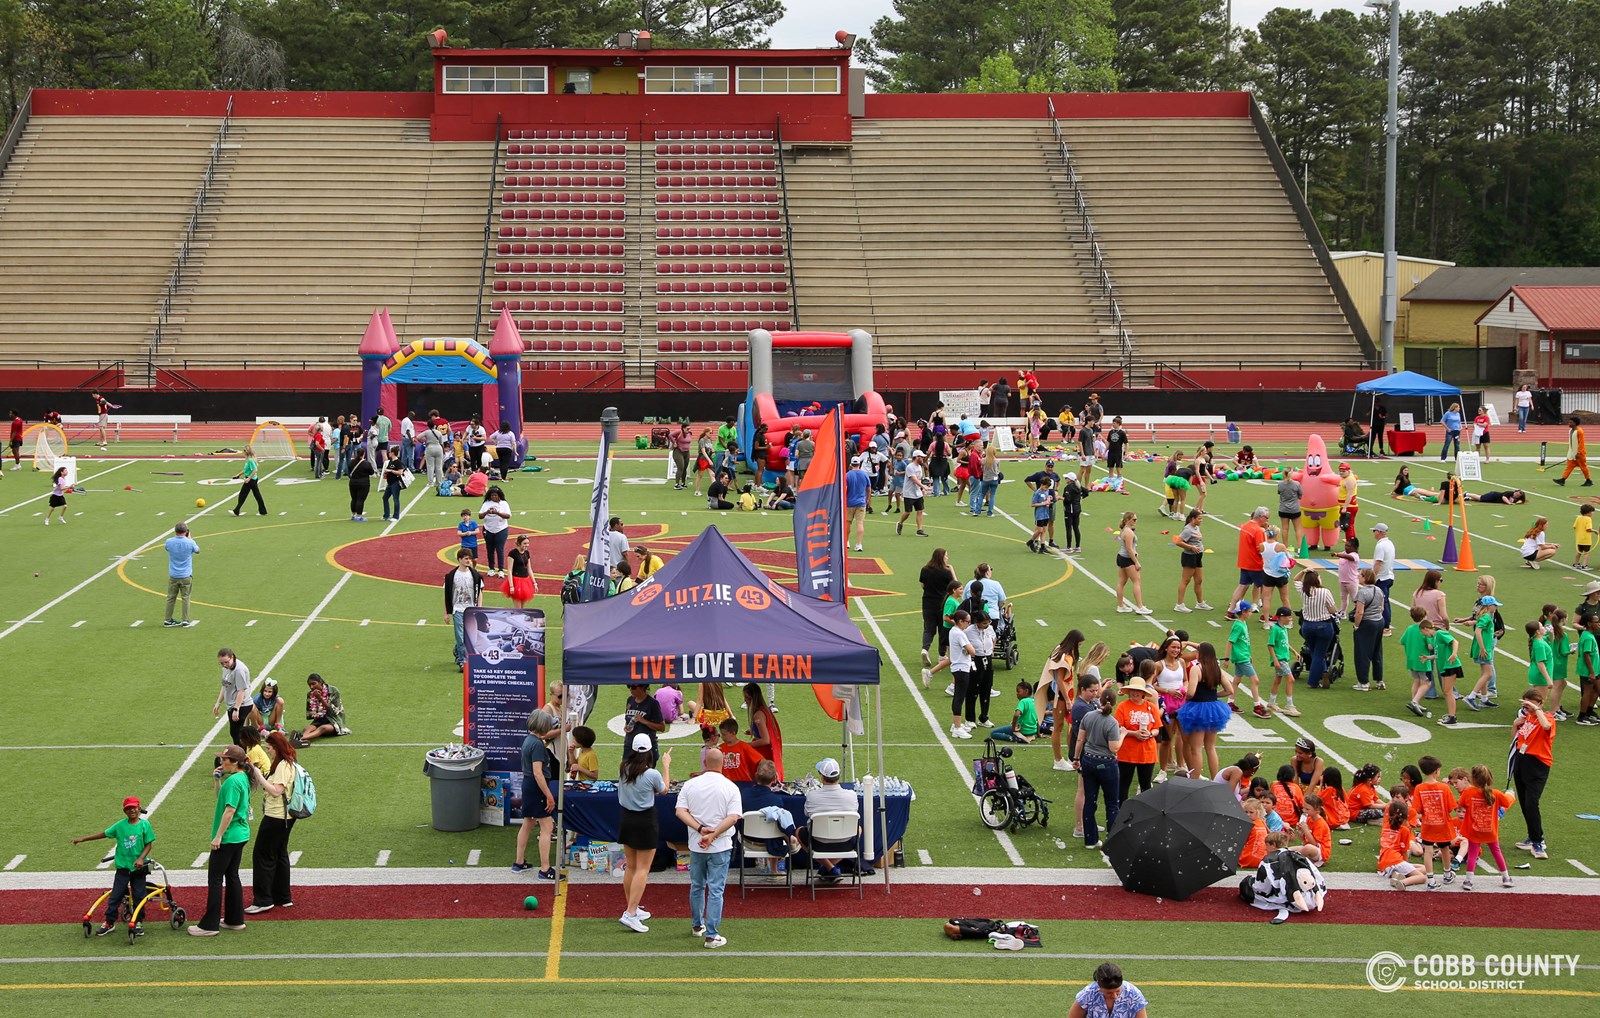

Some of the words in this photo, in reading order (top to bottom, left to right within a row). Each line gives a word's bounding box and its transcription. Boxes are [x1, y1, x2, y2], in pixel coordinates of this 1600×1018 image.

[664, 584, 732, 608] LUTZIE
[740, 589, 764, 606] 43
[488, 650, 499, 660] 43
[630, 655, 676, 679] LIVE
[682, 653, 734, 679] LOVE
[741, 653, 812, 679] LEARN
